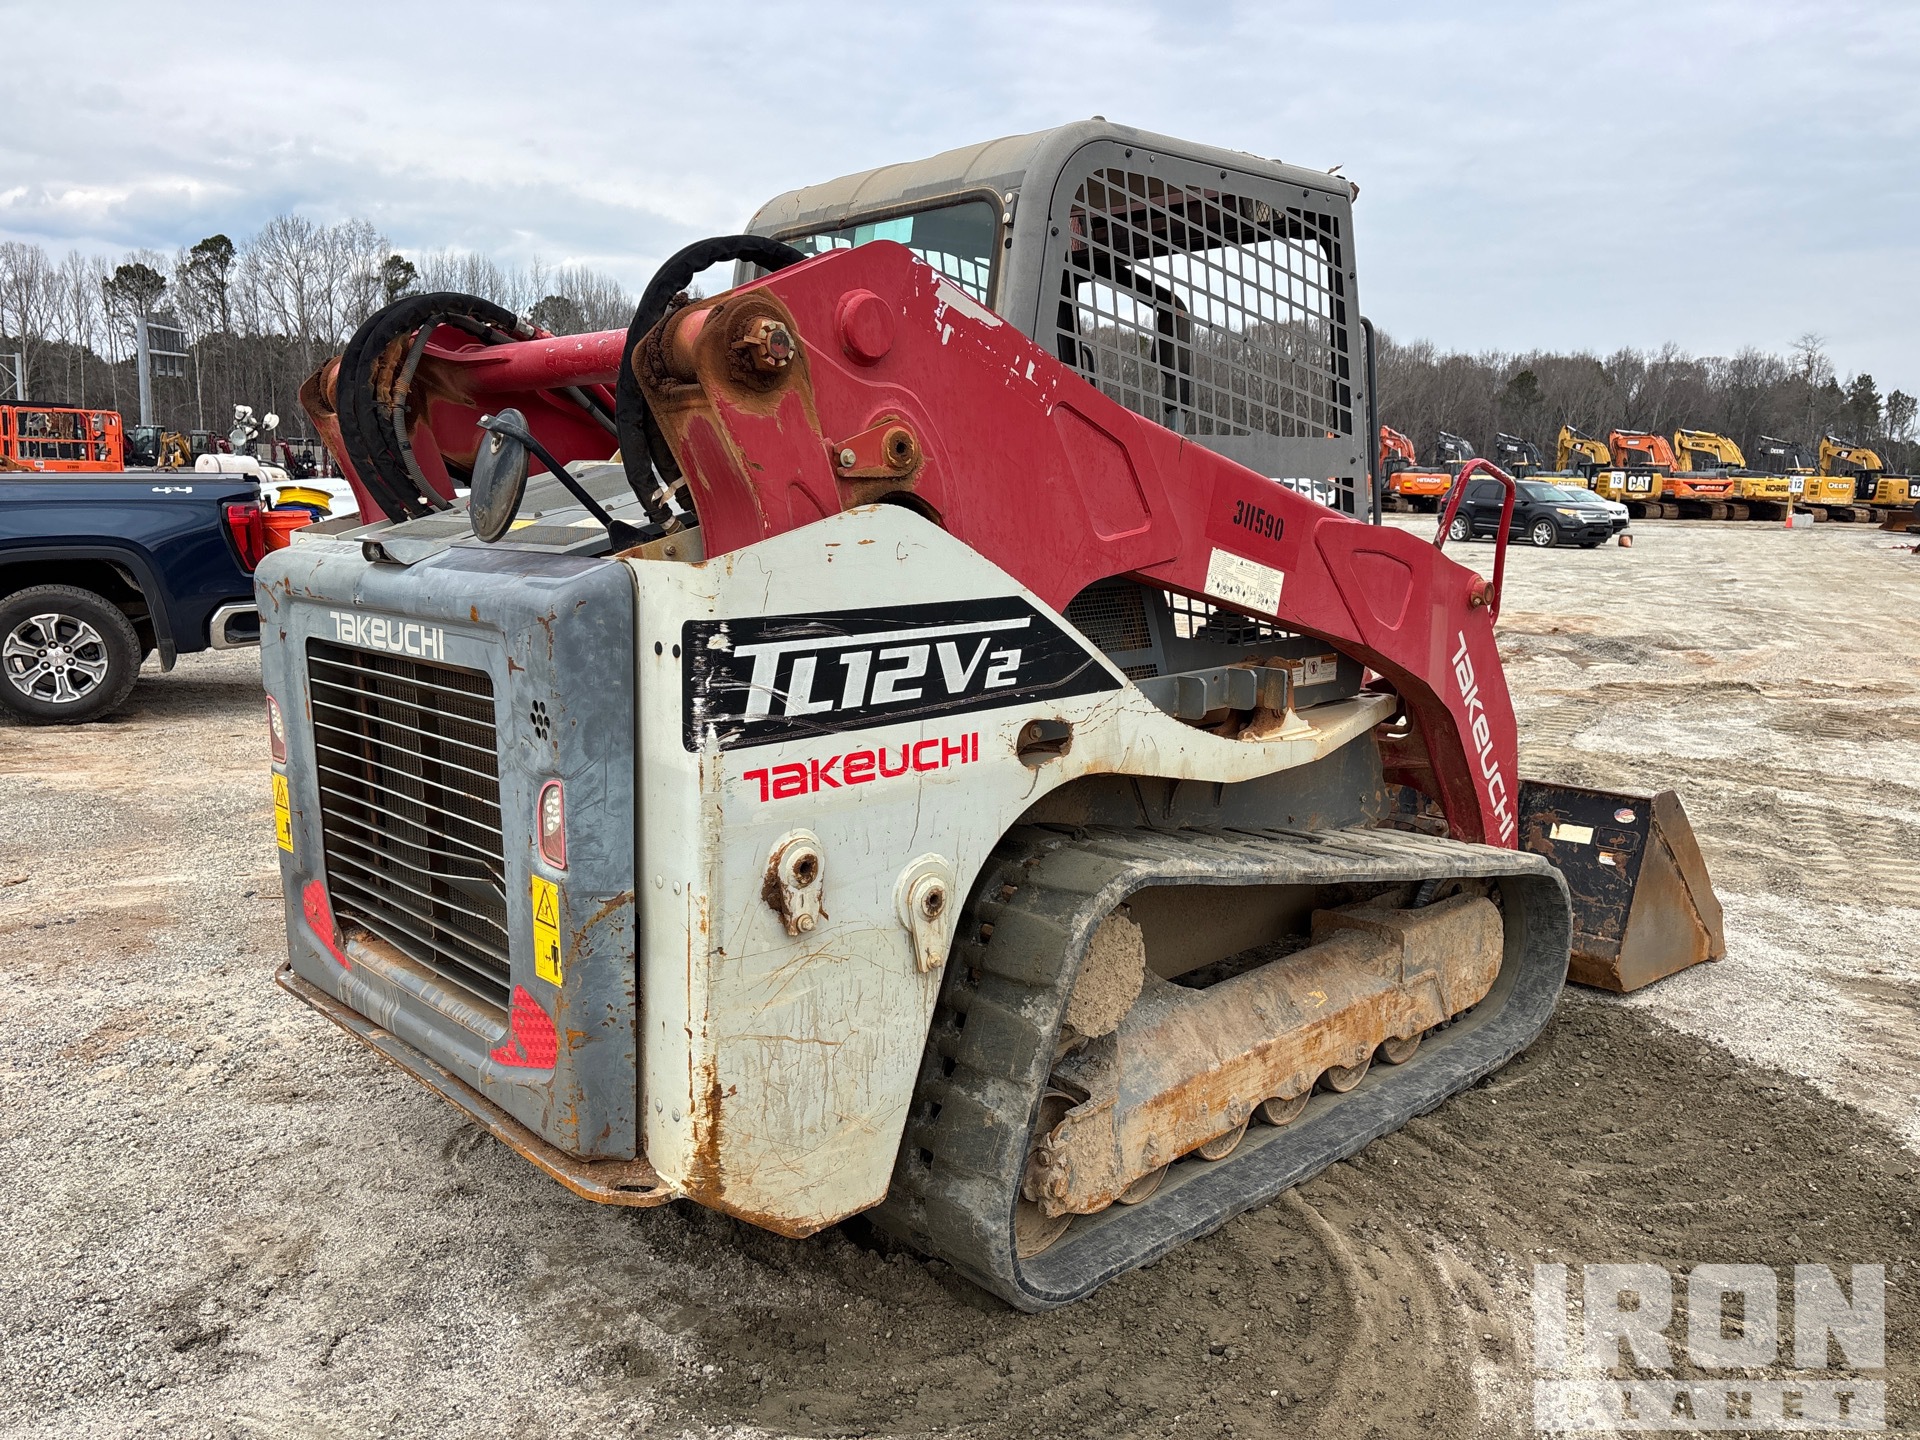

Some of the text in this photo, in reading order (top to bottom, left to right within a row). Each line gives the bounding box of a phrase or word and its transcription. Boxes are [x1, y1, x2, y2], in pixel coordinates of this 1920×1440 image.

[1613, 476, 1622, 485] 13
[1628, 476, 1651, 491] CAT
[1794, 480, 1803, 489] 12
[1232, 499, 1284, 541] 311590
[329, 610, 445, 661] TAKEUCHI
[733, 617, 1031, 723] TL12V2
[743, 732, 979, 803] TAKEUCHI
